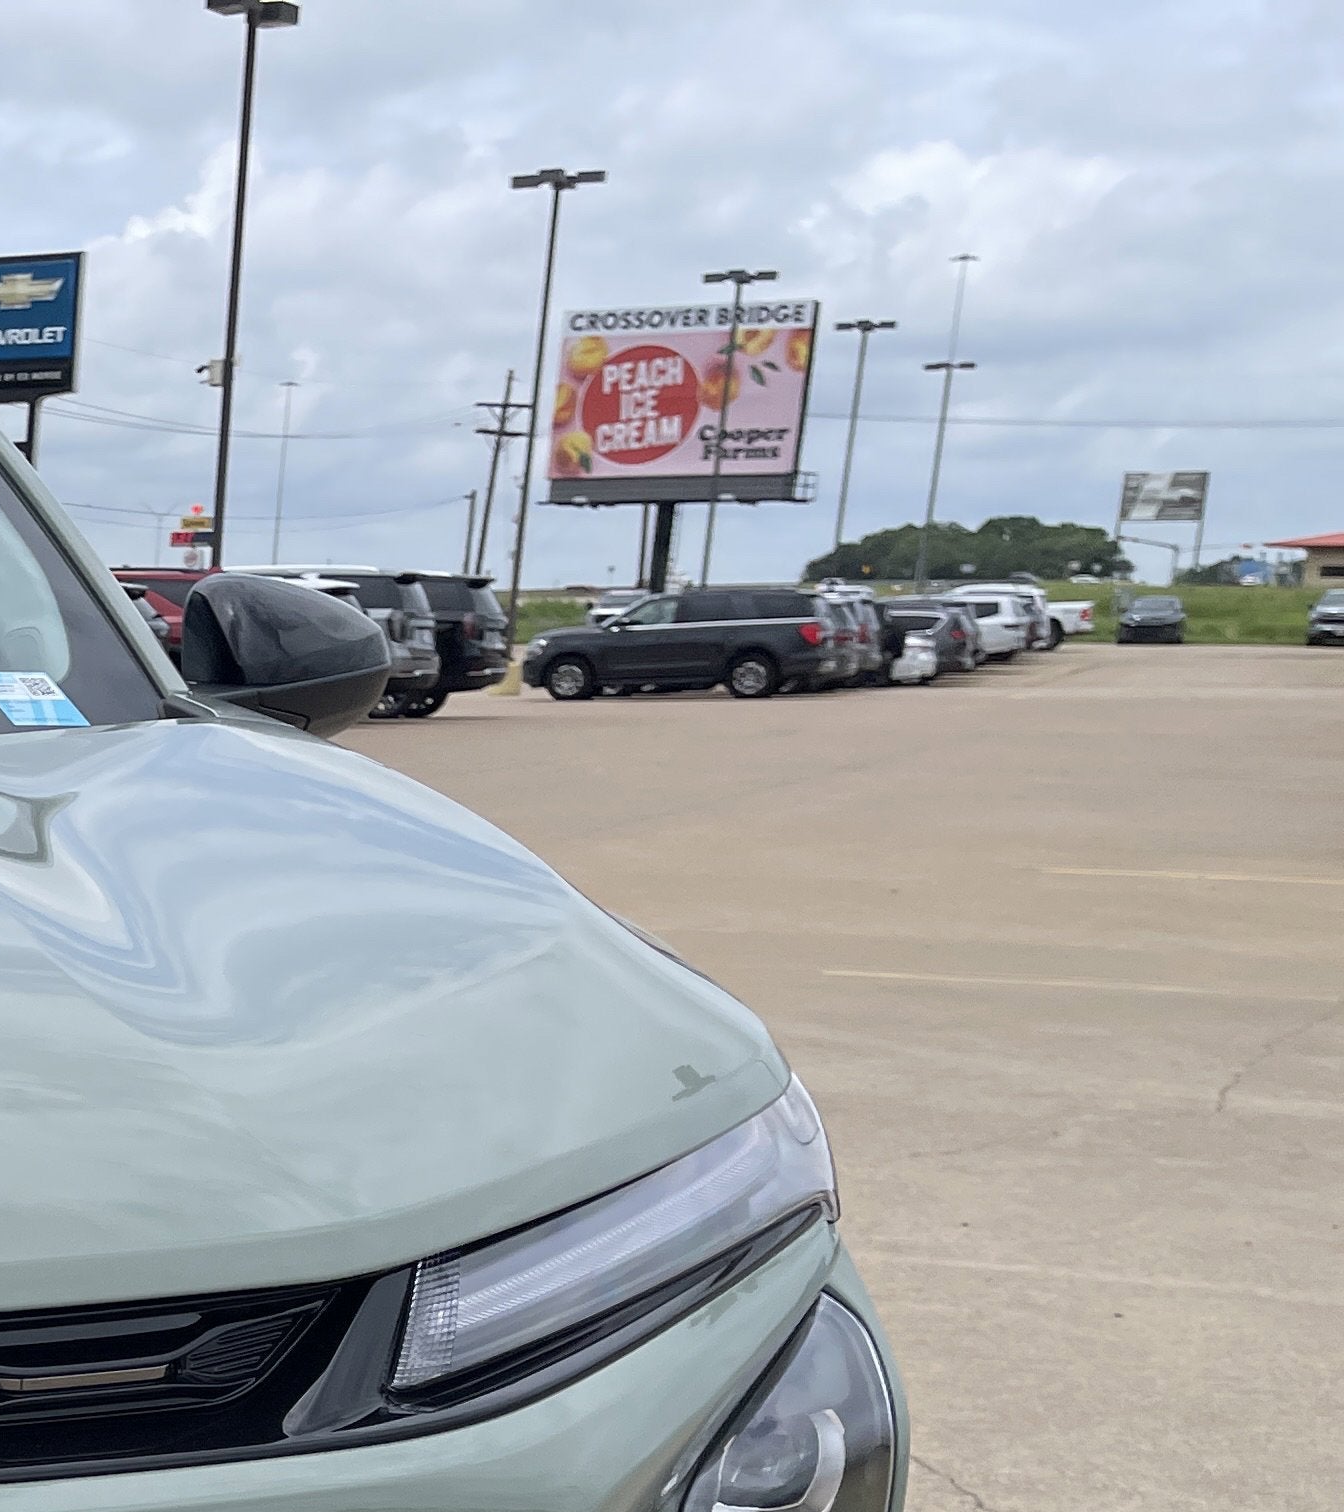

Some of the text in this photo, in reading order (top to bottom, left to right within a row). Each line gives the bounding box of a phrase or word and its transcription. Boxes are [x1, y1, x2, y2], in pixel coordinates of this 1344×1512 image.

[570, 305, 805, 331] CROSSOVER BRIDGE
[601, 356, 684, 394] PEACH
[619, 388, 660, 419] ICE
[595, 417, 682, 454] CREAM
